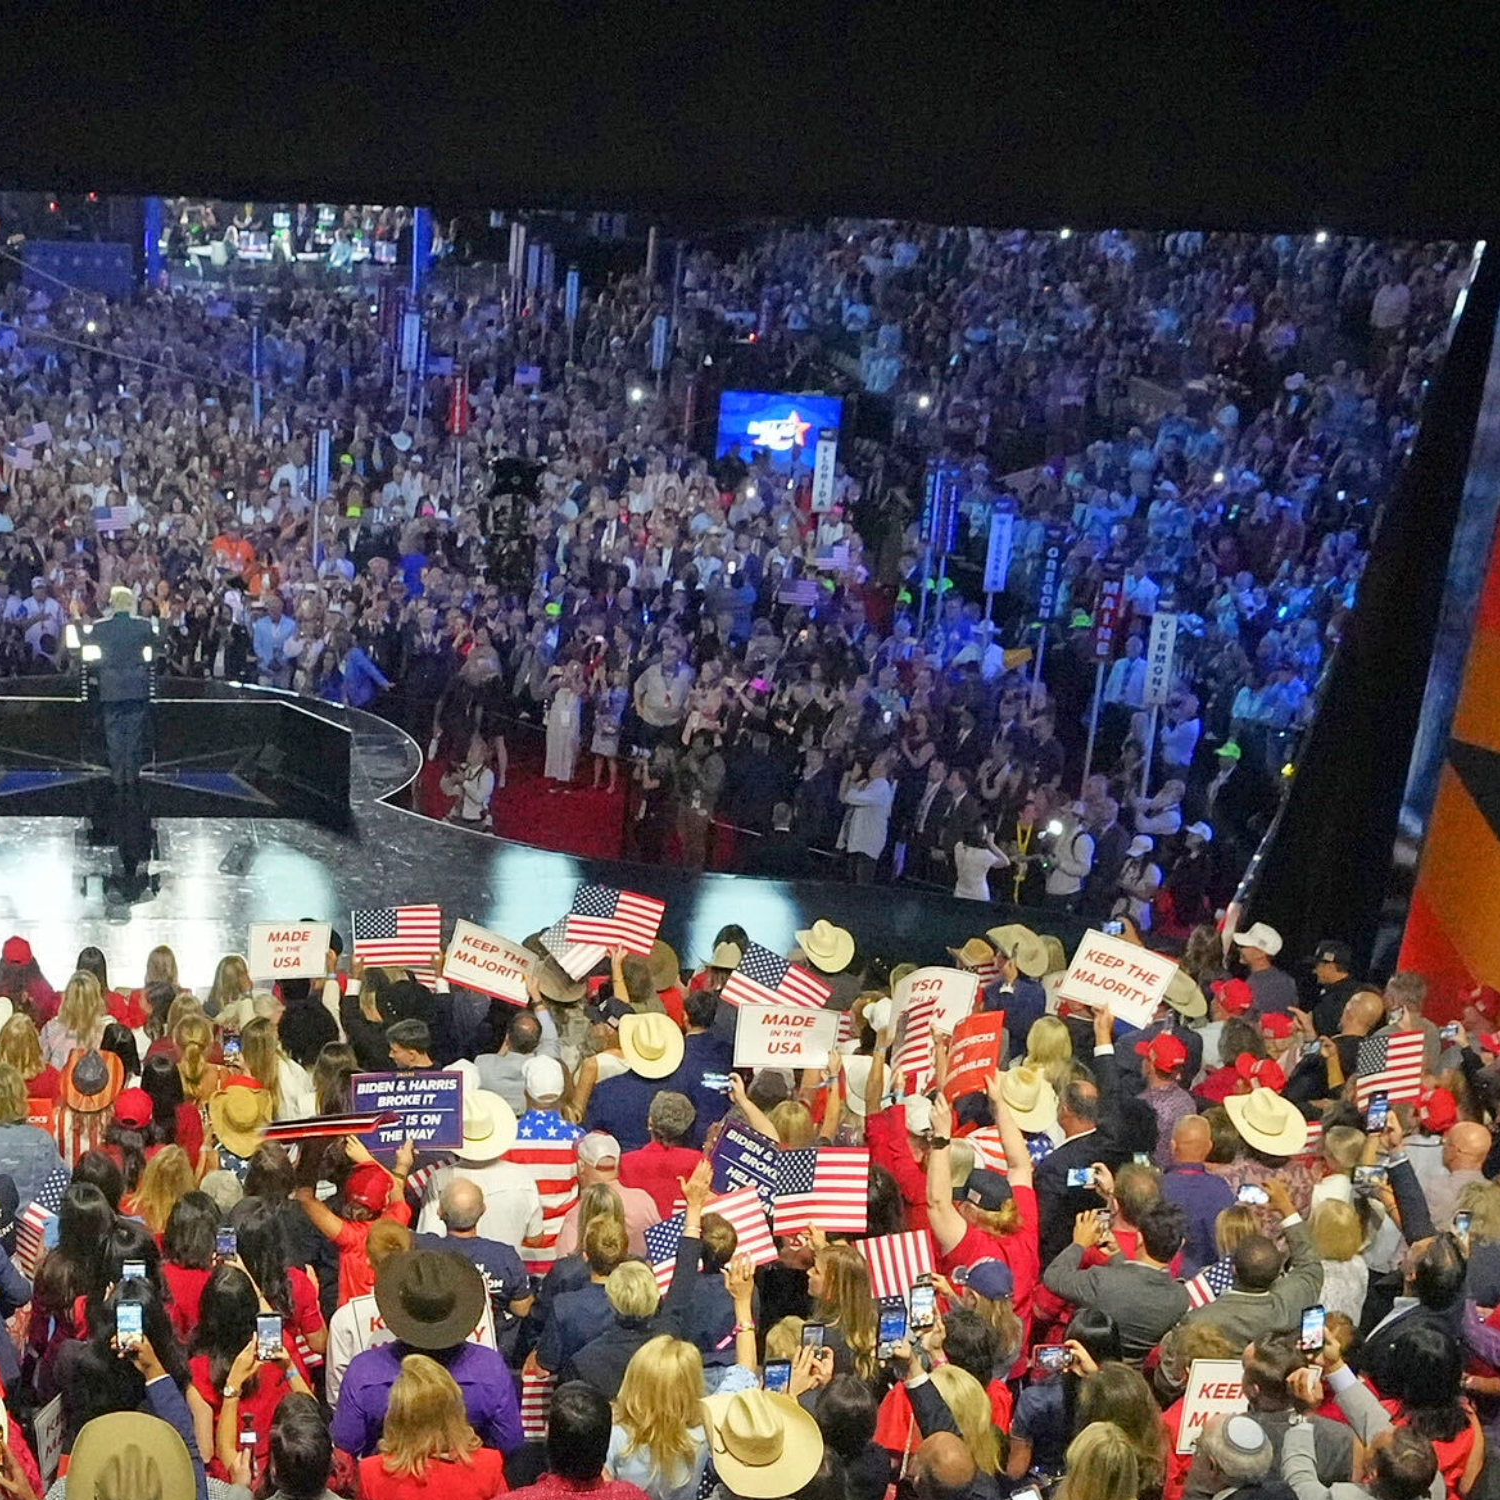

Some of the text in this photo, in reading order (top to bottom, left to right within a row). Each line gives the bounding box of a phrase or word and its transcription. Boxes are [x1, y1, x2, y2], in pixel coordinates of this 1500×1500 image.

[818, 446, 829, 507] FLORIDA
[1038, 547, 1059, 619] OREGON
[1096, 580, 1120, 656] MAINE
[1152, 620, 1168, 697] VERMONT
[267, 930, 311, 942] MADE
[273, 957, 301, 968] USA
[461, 934, 530, 968] KEEP THE
[453, 950, 529, 984] MAJORITY
[1084, 948, 1161, 986] KEEP THE
[911, 978, 943, 992] USA
[1071, 968, 1154, 1007] MAJORITY
[761, 1013, 817, 1028] MADE
[769, 1029, 803, 1038] IN THE
[767, 1042, 803, 1054] USA
[357, 1079, 457, 1095] BIDEN & HARRIS
[377, 1094, 437, 1107] BROKE IT
[405, 1114, 442, 1126] IS ON
[379, 1128, 436, 1143] THE WAY
[726, 1129, 774, 1162] BIDEN &
[725, 1166, 759, 1187] HELP
[757, 1184, 771, 1197] IS
